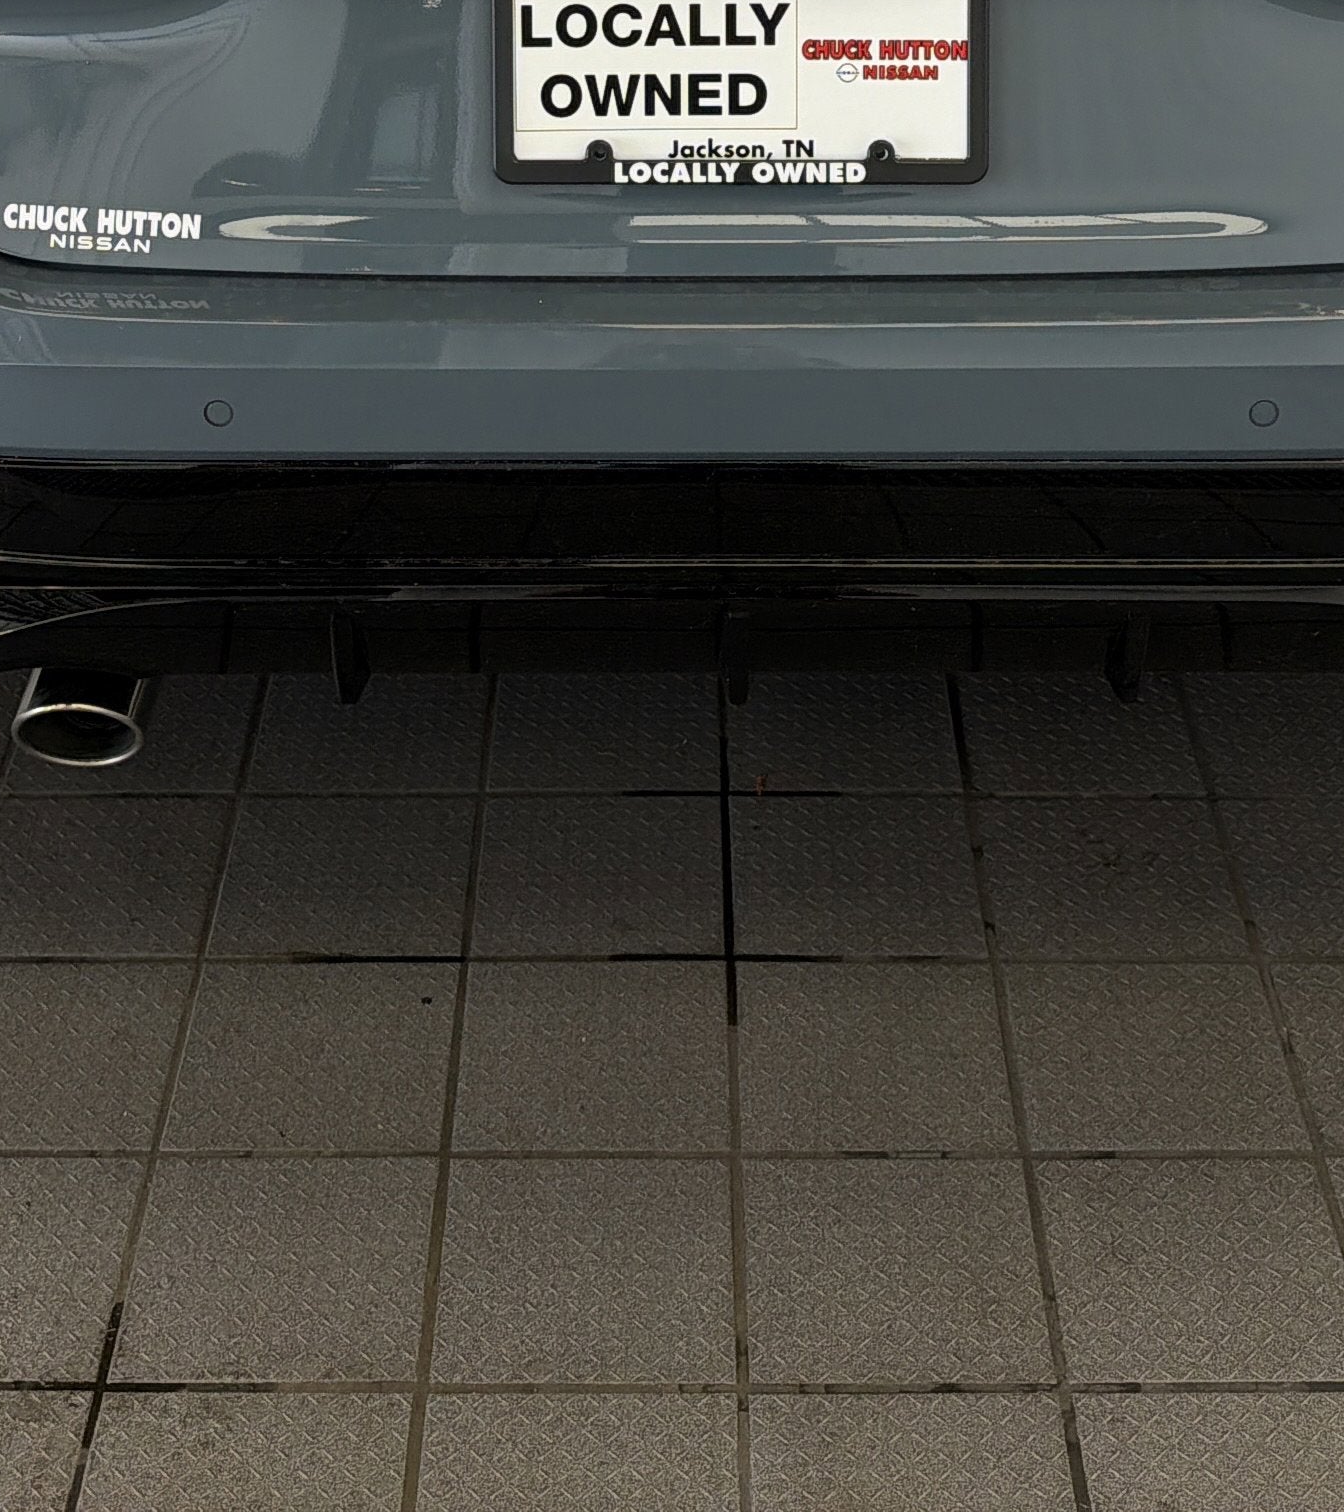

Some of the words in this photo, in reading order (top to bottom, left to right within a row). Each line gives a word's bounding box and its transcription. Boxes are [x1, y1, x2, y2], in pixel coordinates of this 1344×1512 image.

[519, 2, 792, 49] LOCALLY
[801, 38, 873, 61] CHUCK
[879, 39, 969, 62] HUTTON
[862, 64, 939, 81] NISSAN
[539, 73, 768, 117] OWNED
[667, 138, 773, 161] Jackson,
[781, 139, 815, 159] TN
[613, 161, 740, 184] LOCALLY
[751, 161, 867, 184] OWNED
[3, 203, 89, 234] CHUCK
[96, 208, 202, 241] HUTTON
[49, 233, 153, 254] NISSAN
